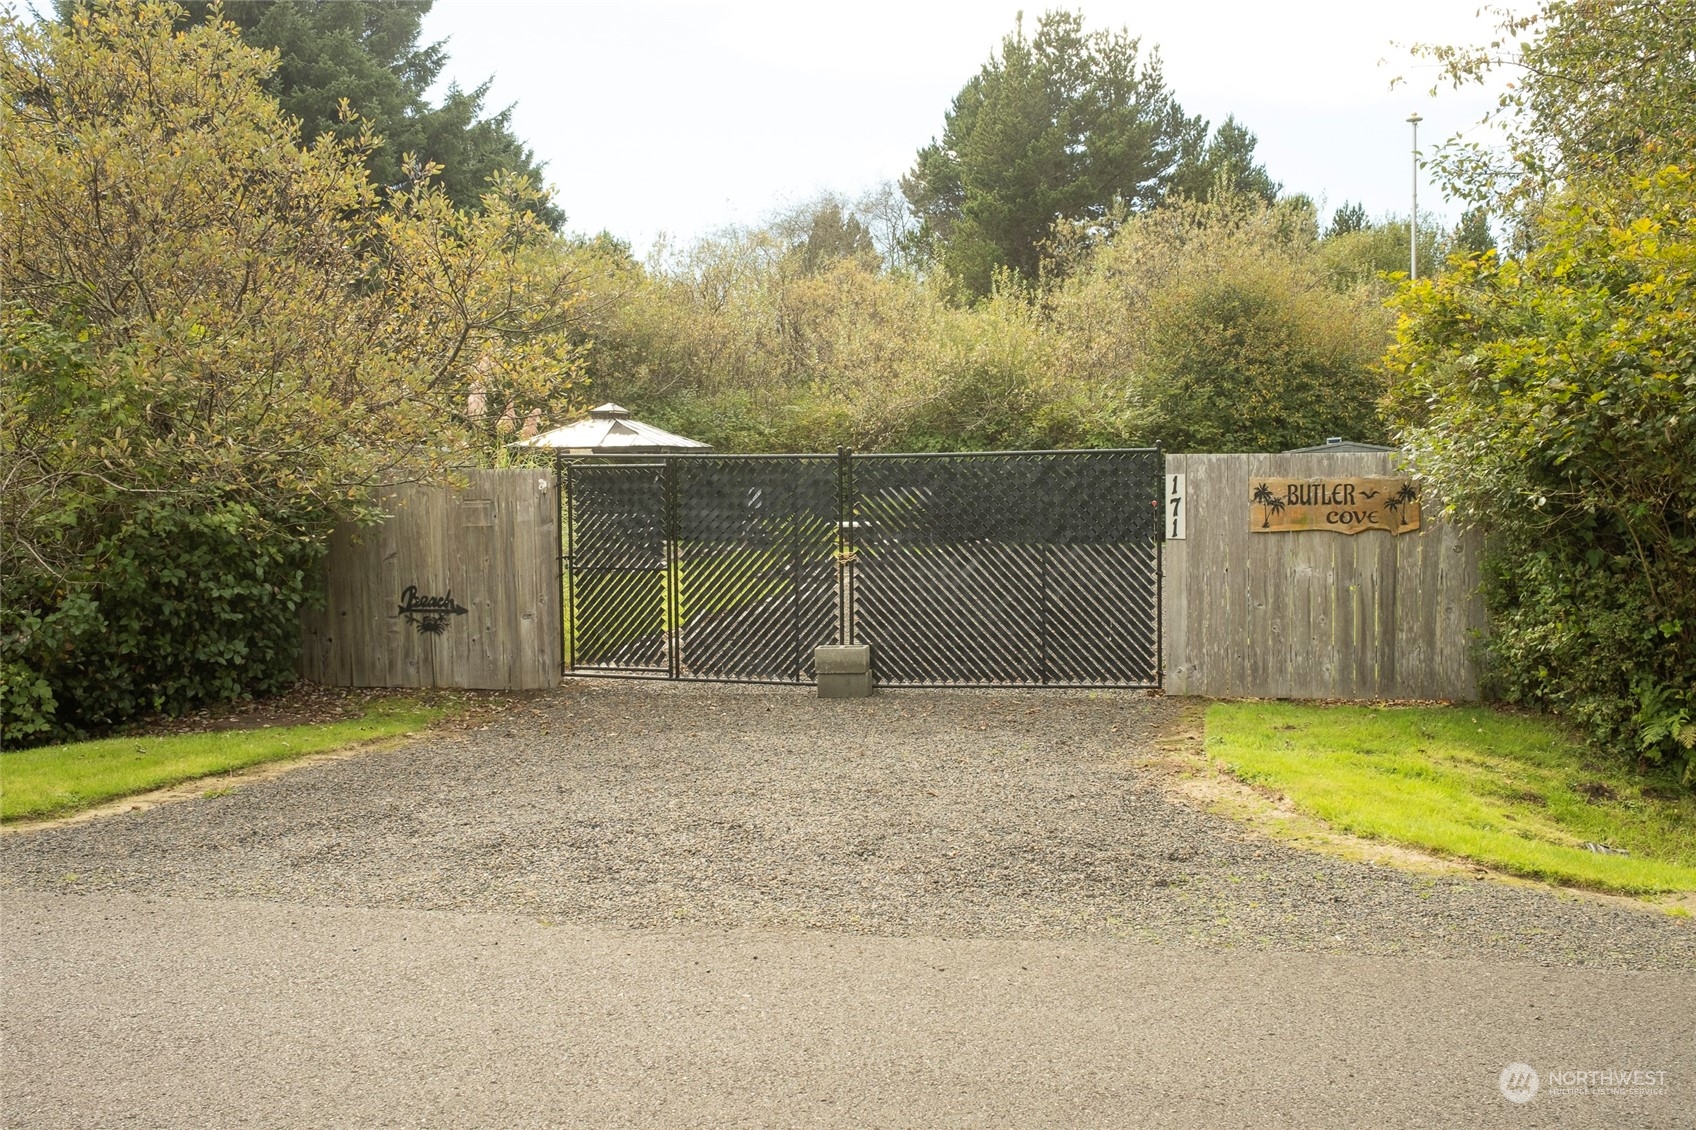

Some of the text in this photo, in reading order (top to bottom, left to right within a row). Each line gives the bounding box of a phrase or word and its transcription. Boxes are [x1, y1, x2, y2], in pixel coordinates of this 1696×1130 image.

[1170, 475, 1181, 538] 171
[1287, 483, 1356, 506] BUTLER
[1326, 510, 1379, 525] COVE
[401, 585, 455, 610] Beach
